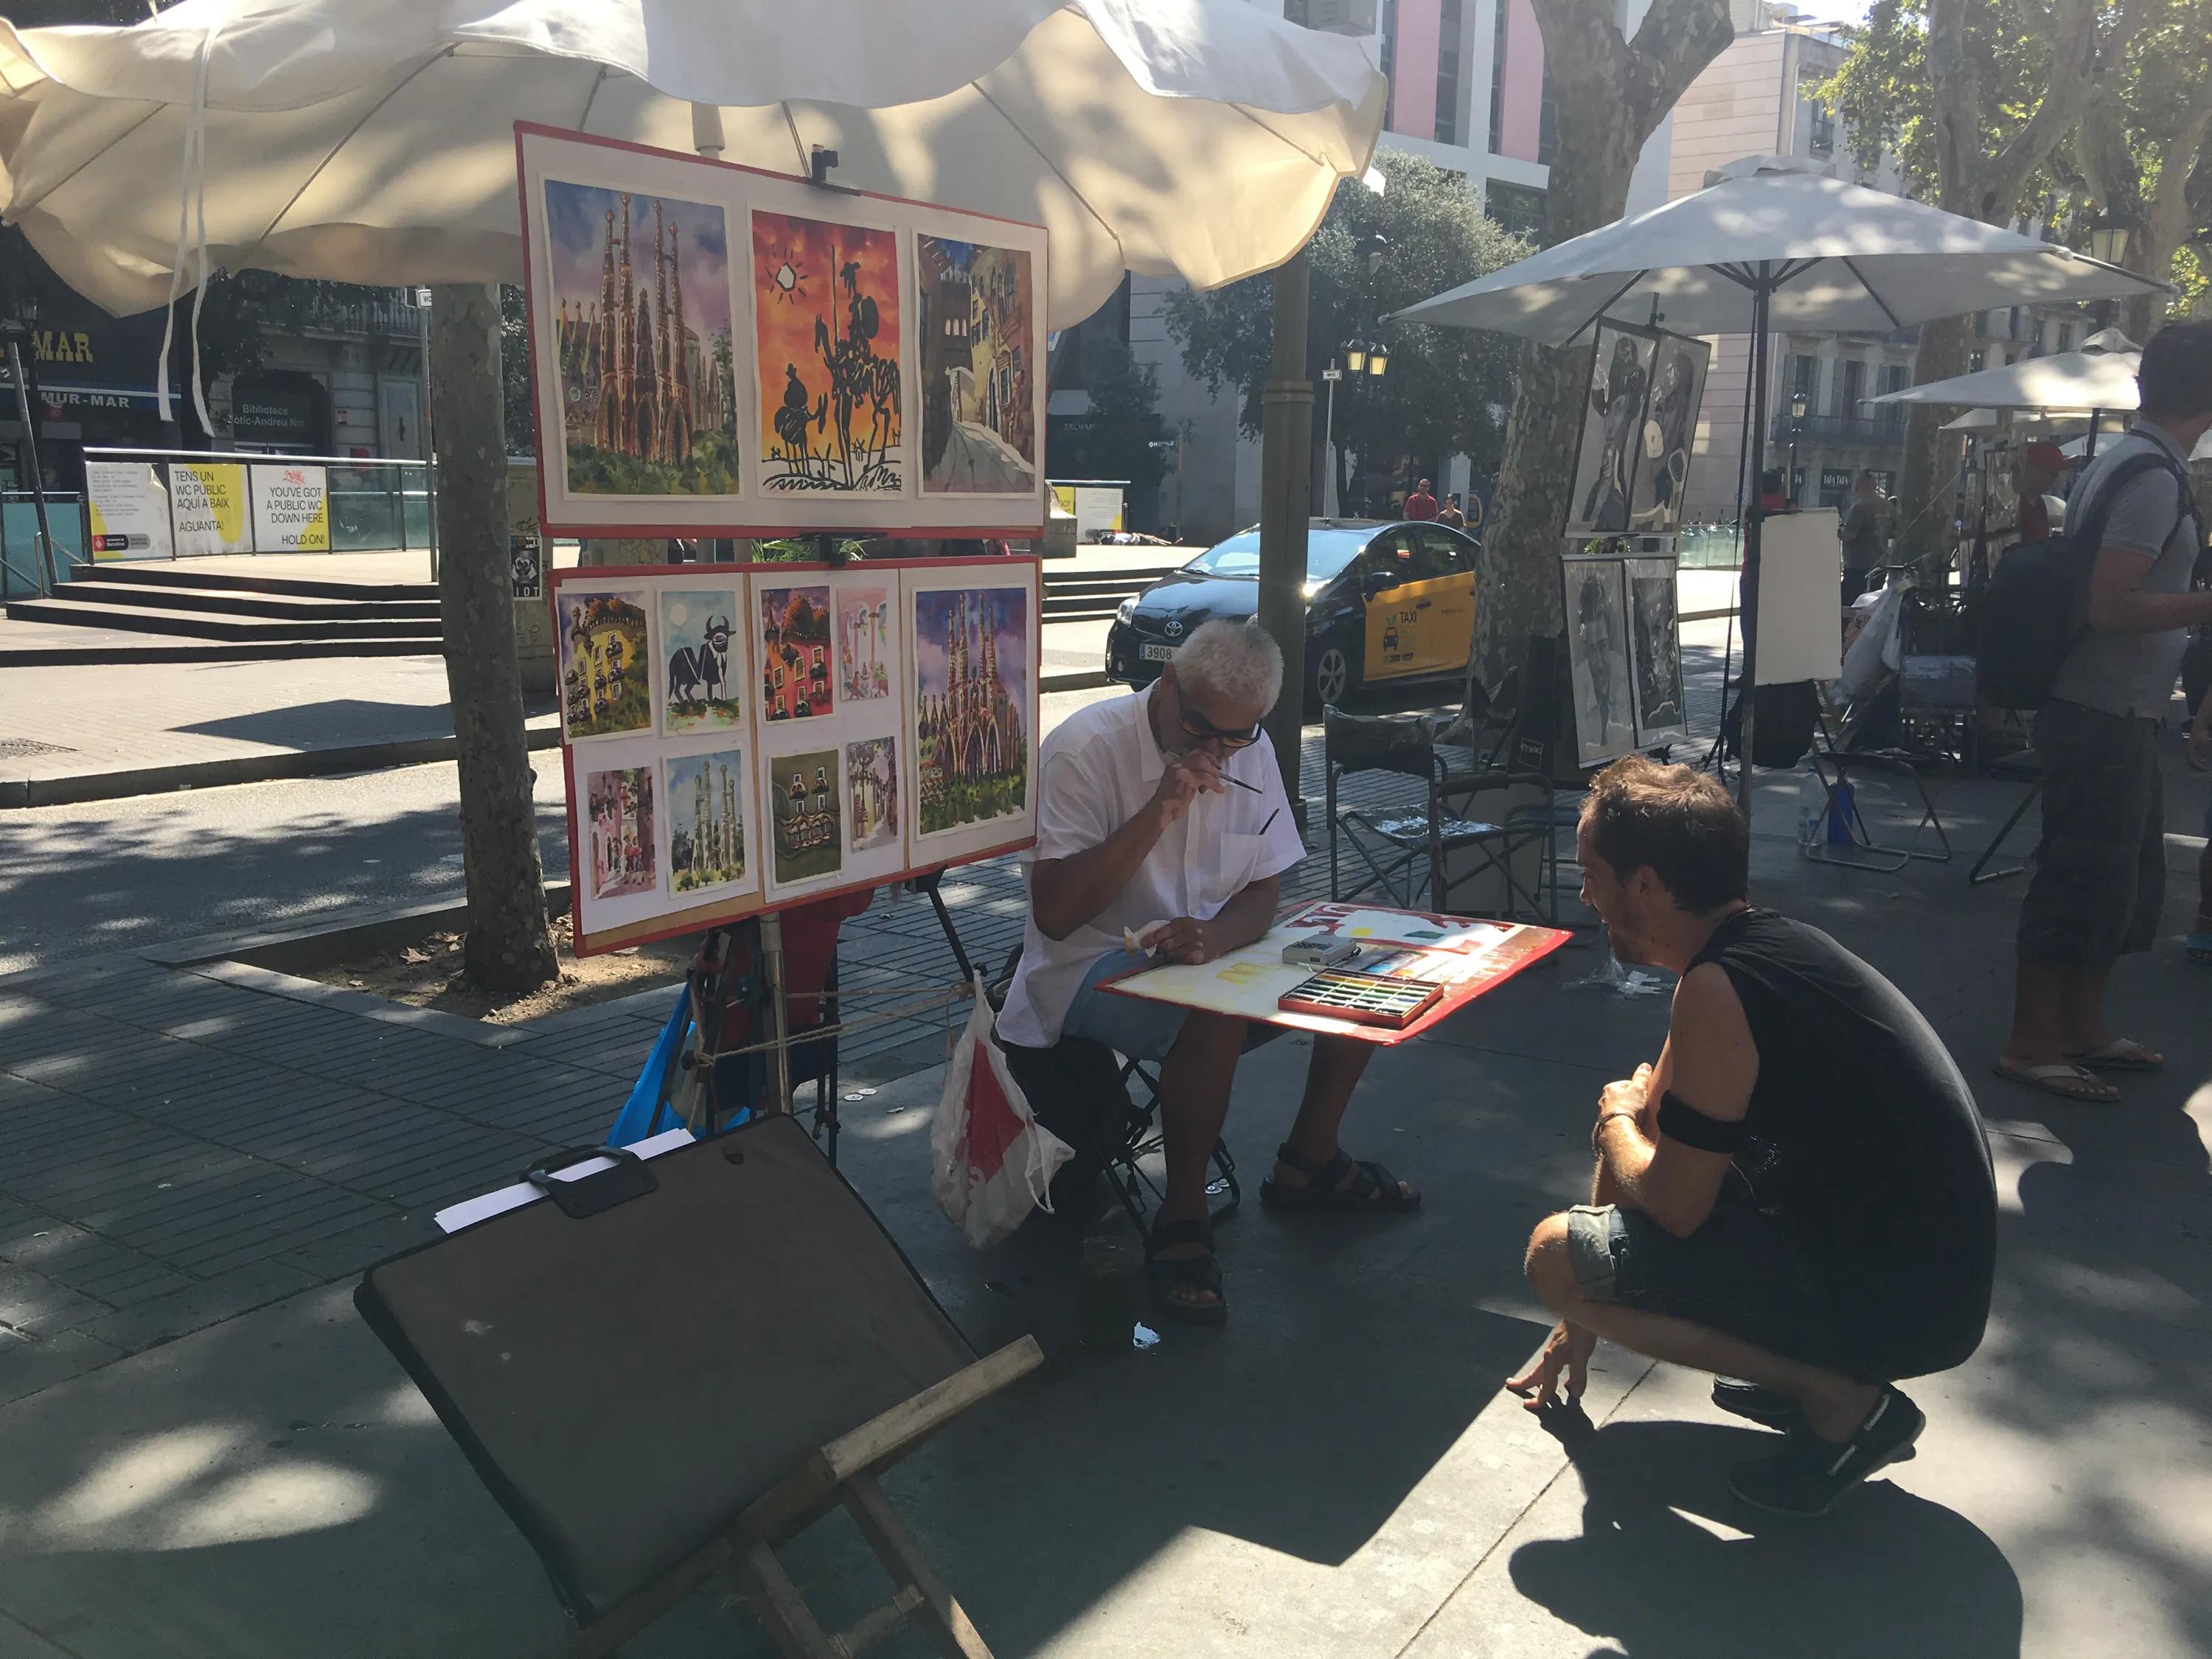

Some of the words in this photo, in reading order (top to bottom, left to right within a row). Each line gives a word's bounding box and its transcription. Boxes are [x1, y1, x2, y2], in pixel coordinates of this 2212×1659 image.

[41, 392, 130, 408] MUR-MAR
[243, 403, 288, 416] Biblioteca
[174, 471, 198, 481] TENS
[200, 471, 214, 481] UN
[175, 484, 192, 495] WC
[303, 487, 321, 498] GOT
[177, 495, 200, 510] AQUÍ
[202, 498, 209, 508] A
[210, 498, 229, 508] BAIX
[266, 500, 273, 510] A
[274, 500, 306, 510] PUBLIC
[307, 500, 323, 510] WC
[271, 513, 300, 524] DOWN
[302, 512, 324, 523] HERE
[179, 521, 224, 532] AGUANTA!
[282, 534, 307, 545] HOLD
[308, 534, 324, 544] ON!
[1399, 611, 1417, 624] TAXI
[1147, 647, 1172, 660] 3908
